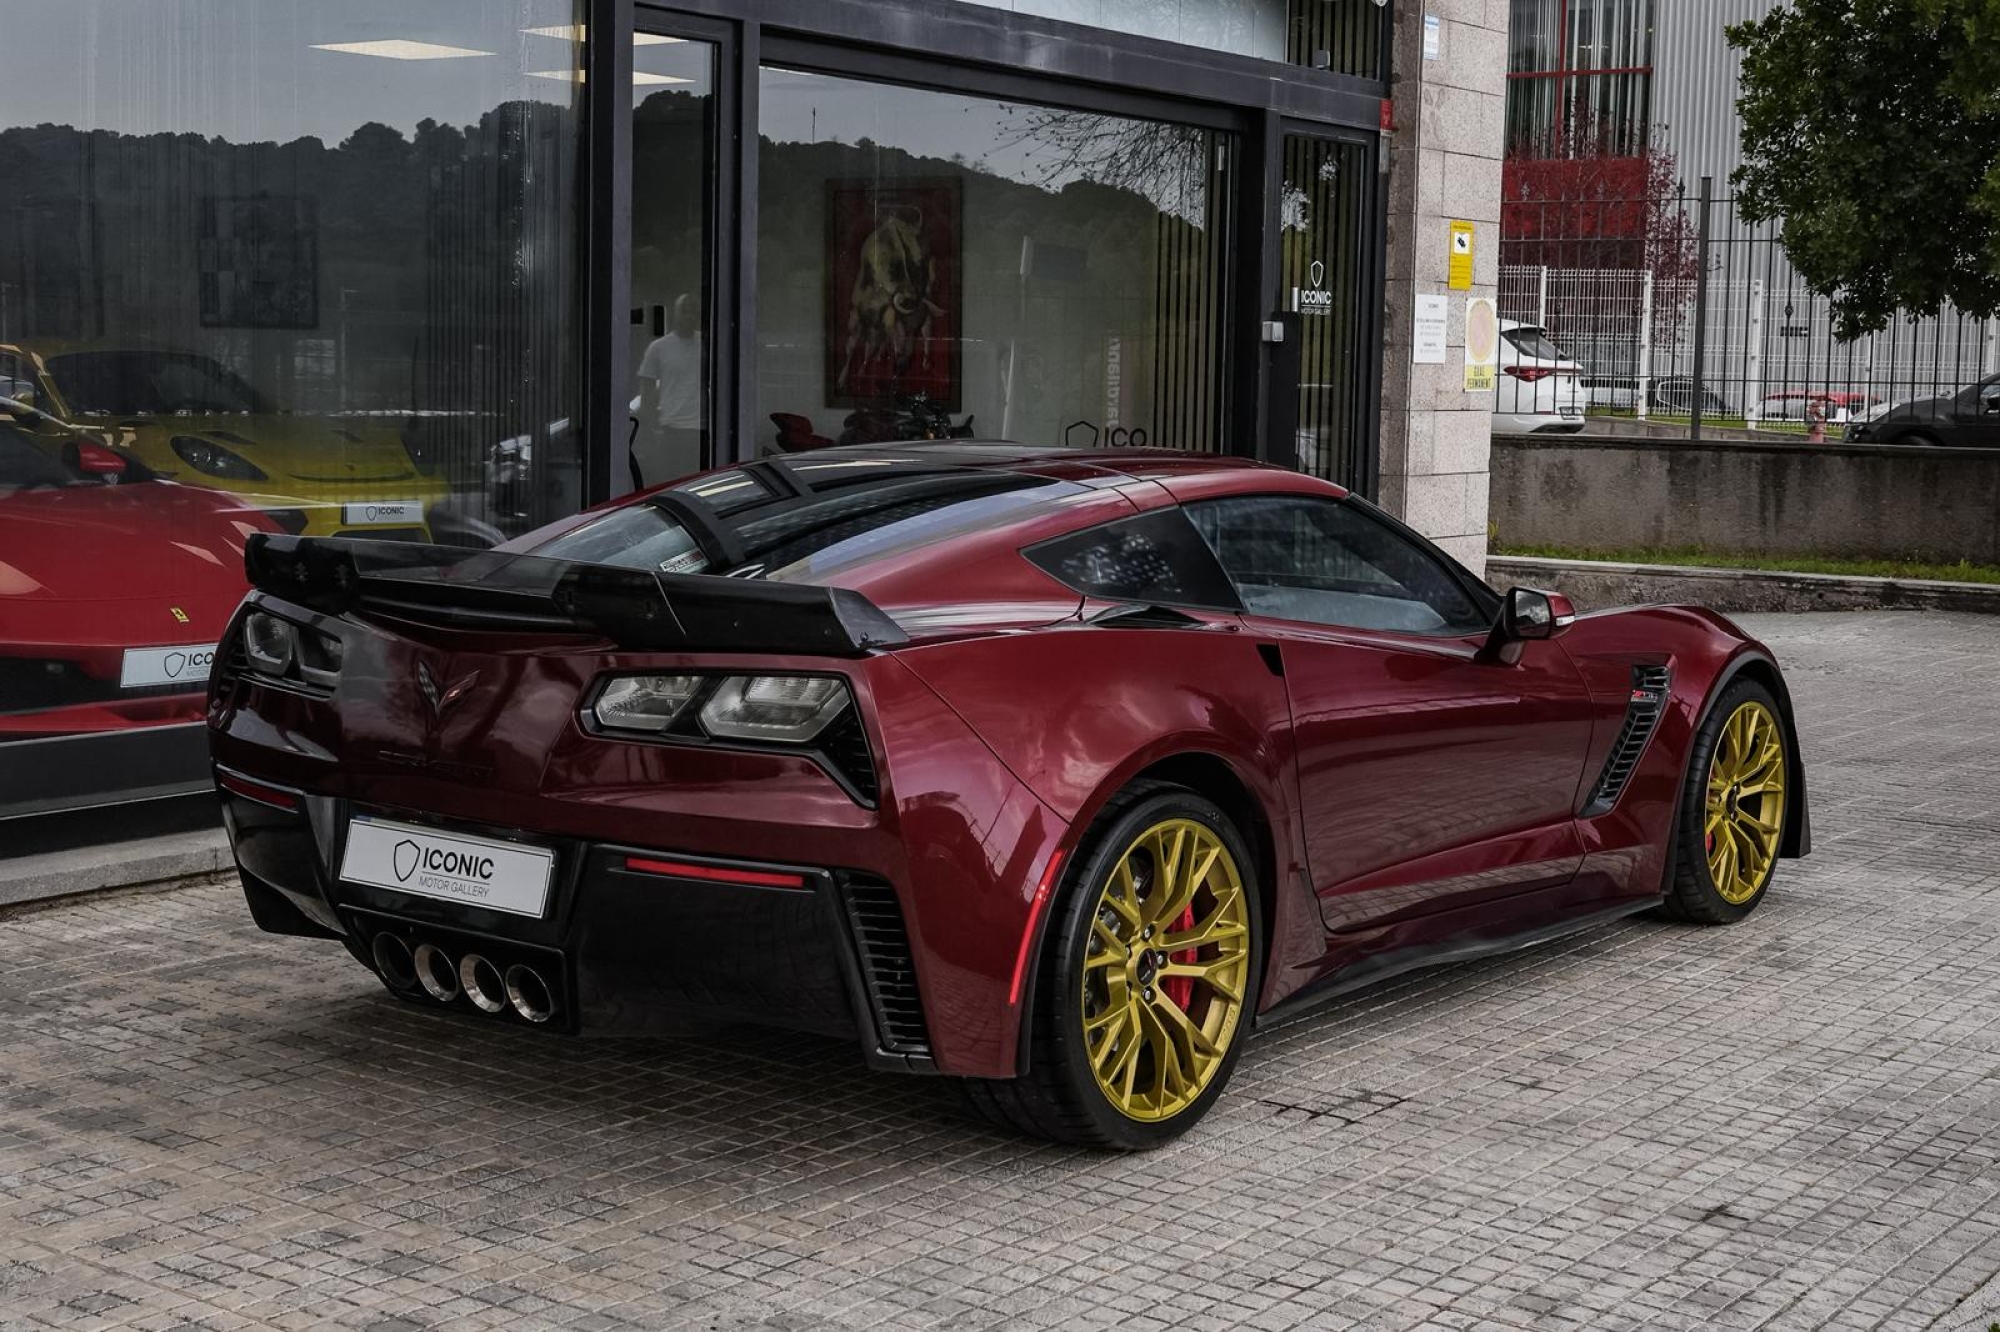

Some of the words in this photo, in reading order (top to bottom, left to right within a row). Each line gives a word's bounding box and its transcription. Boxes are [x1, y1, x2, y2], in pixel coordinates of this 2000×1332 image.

[1301, 290, 1332, 305] ICONIC
[378, 506, 405, 515] ICONIC
[423, 847, 494, 880] ICONIC
[419, 875, 450, 891] MOTOR
[451, 881, 490, 898] GALLERY
